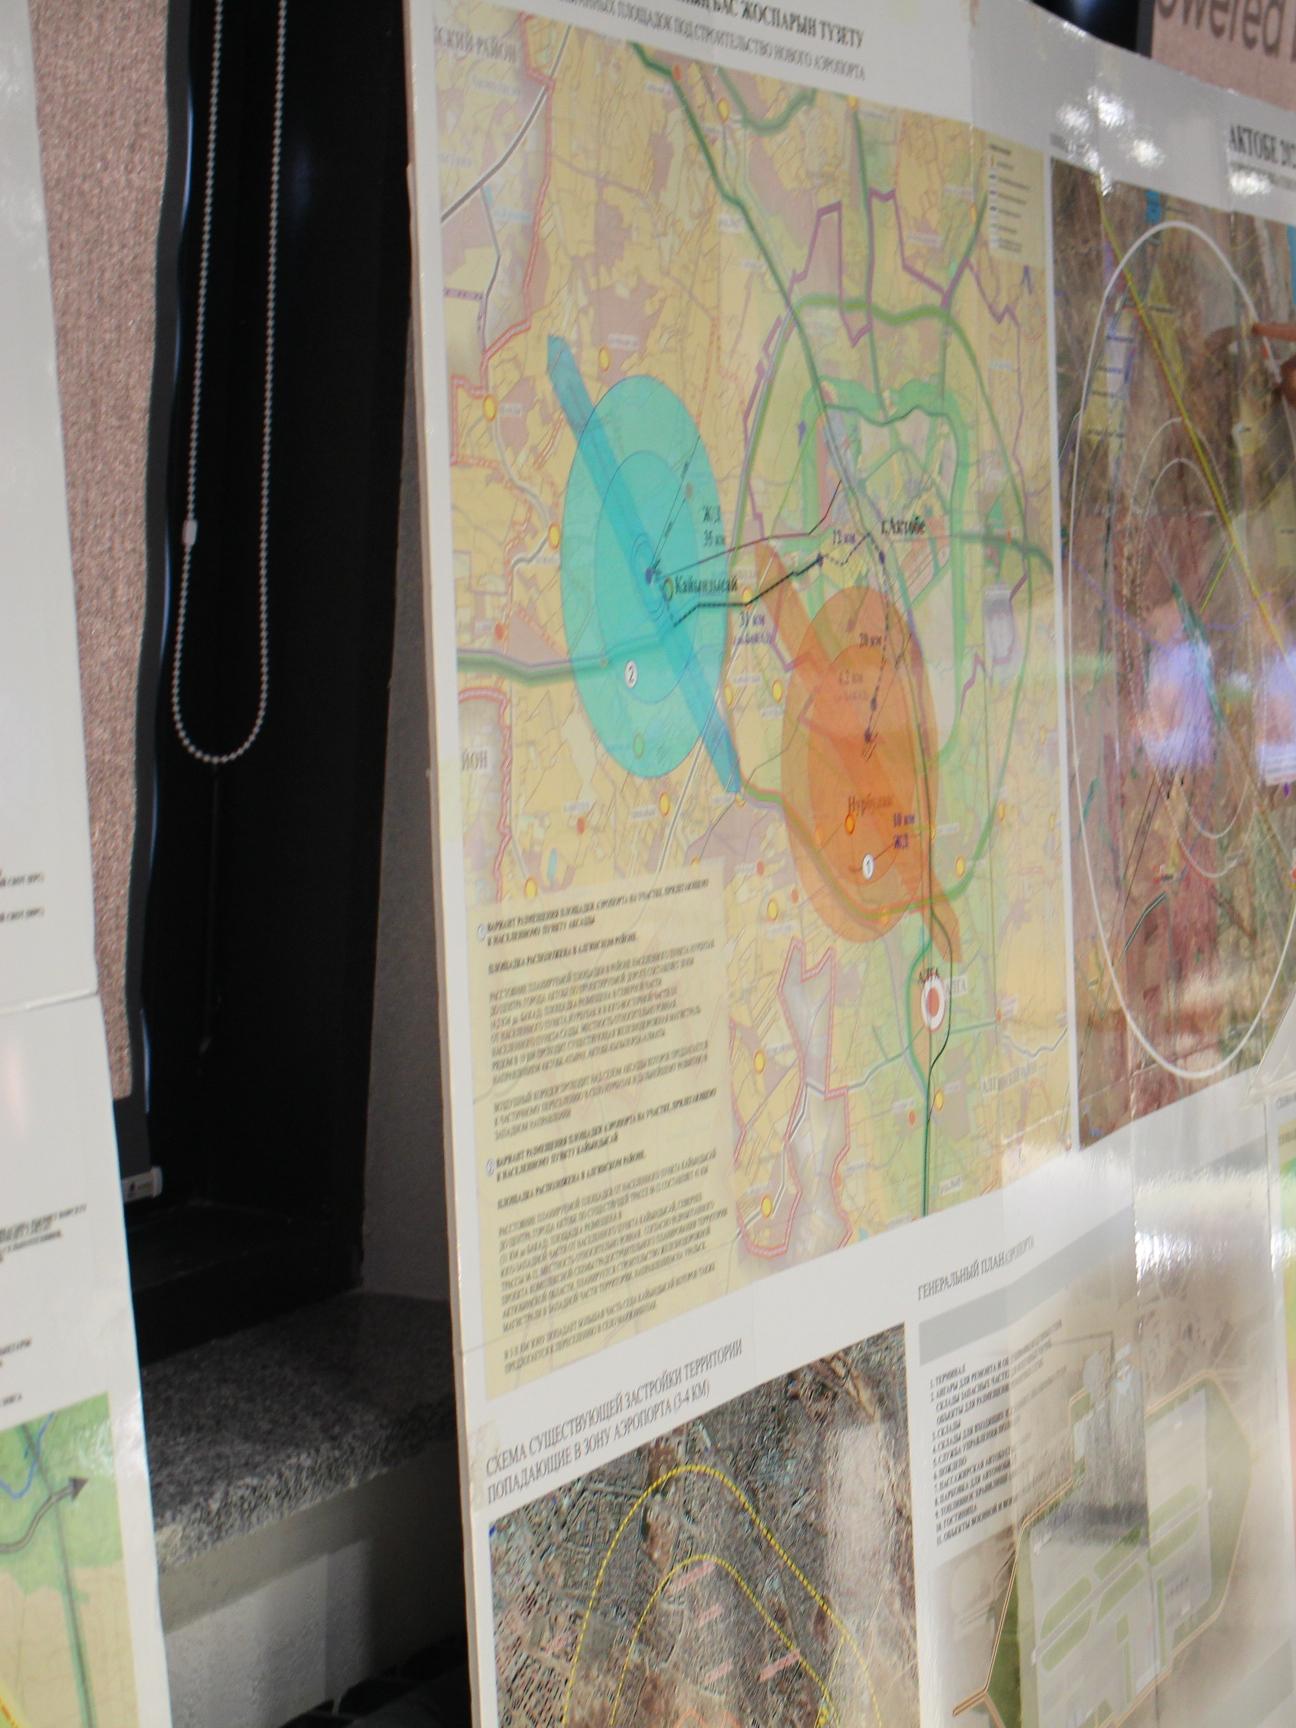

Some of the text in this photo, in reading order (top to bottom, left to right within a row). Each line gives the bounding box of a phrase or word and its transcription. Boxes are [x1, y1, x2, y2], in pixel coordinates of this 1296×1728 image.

[918, 1258, 980, 1301] ГЕНЕРАЛЬНЫЙ
[981, 1252, 1005, 1275] ПЛАН
[486, 1339, 742, 1476] СХЕМА СУЩЕСТВУЮЩЕЙ ЗАСТРОЙКИ ТЕРРИТОРИИ
[487, 1457, 572, 1505] ПОПАДАЮЩИЕ
[573, 1443, 581, 1460] В
[584, 1432, 611, 1458] ЗОНУ
[613, 1404, 672, 1446] АЭРОПОРТА
